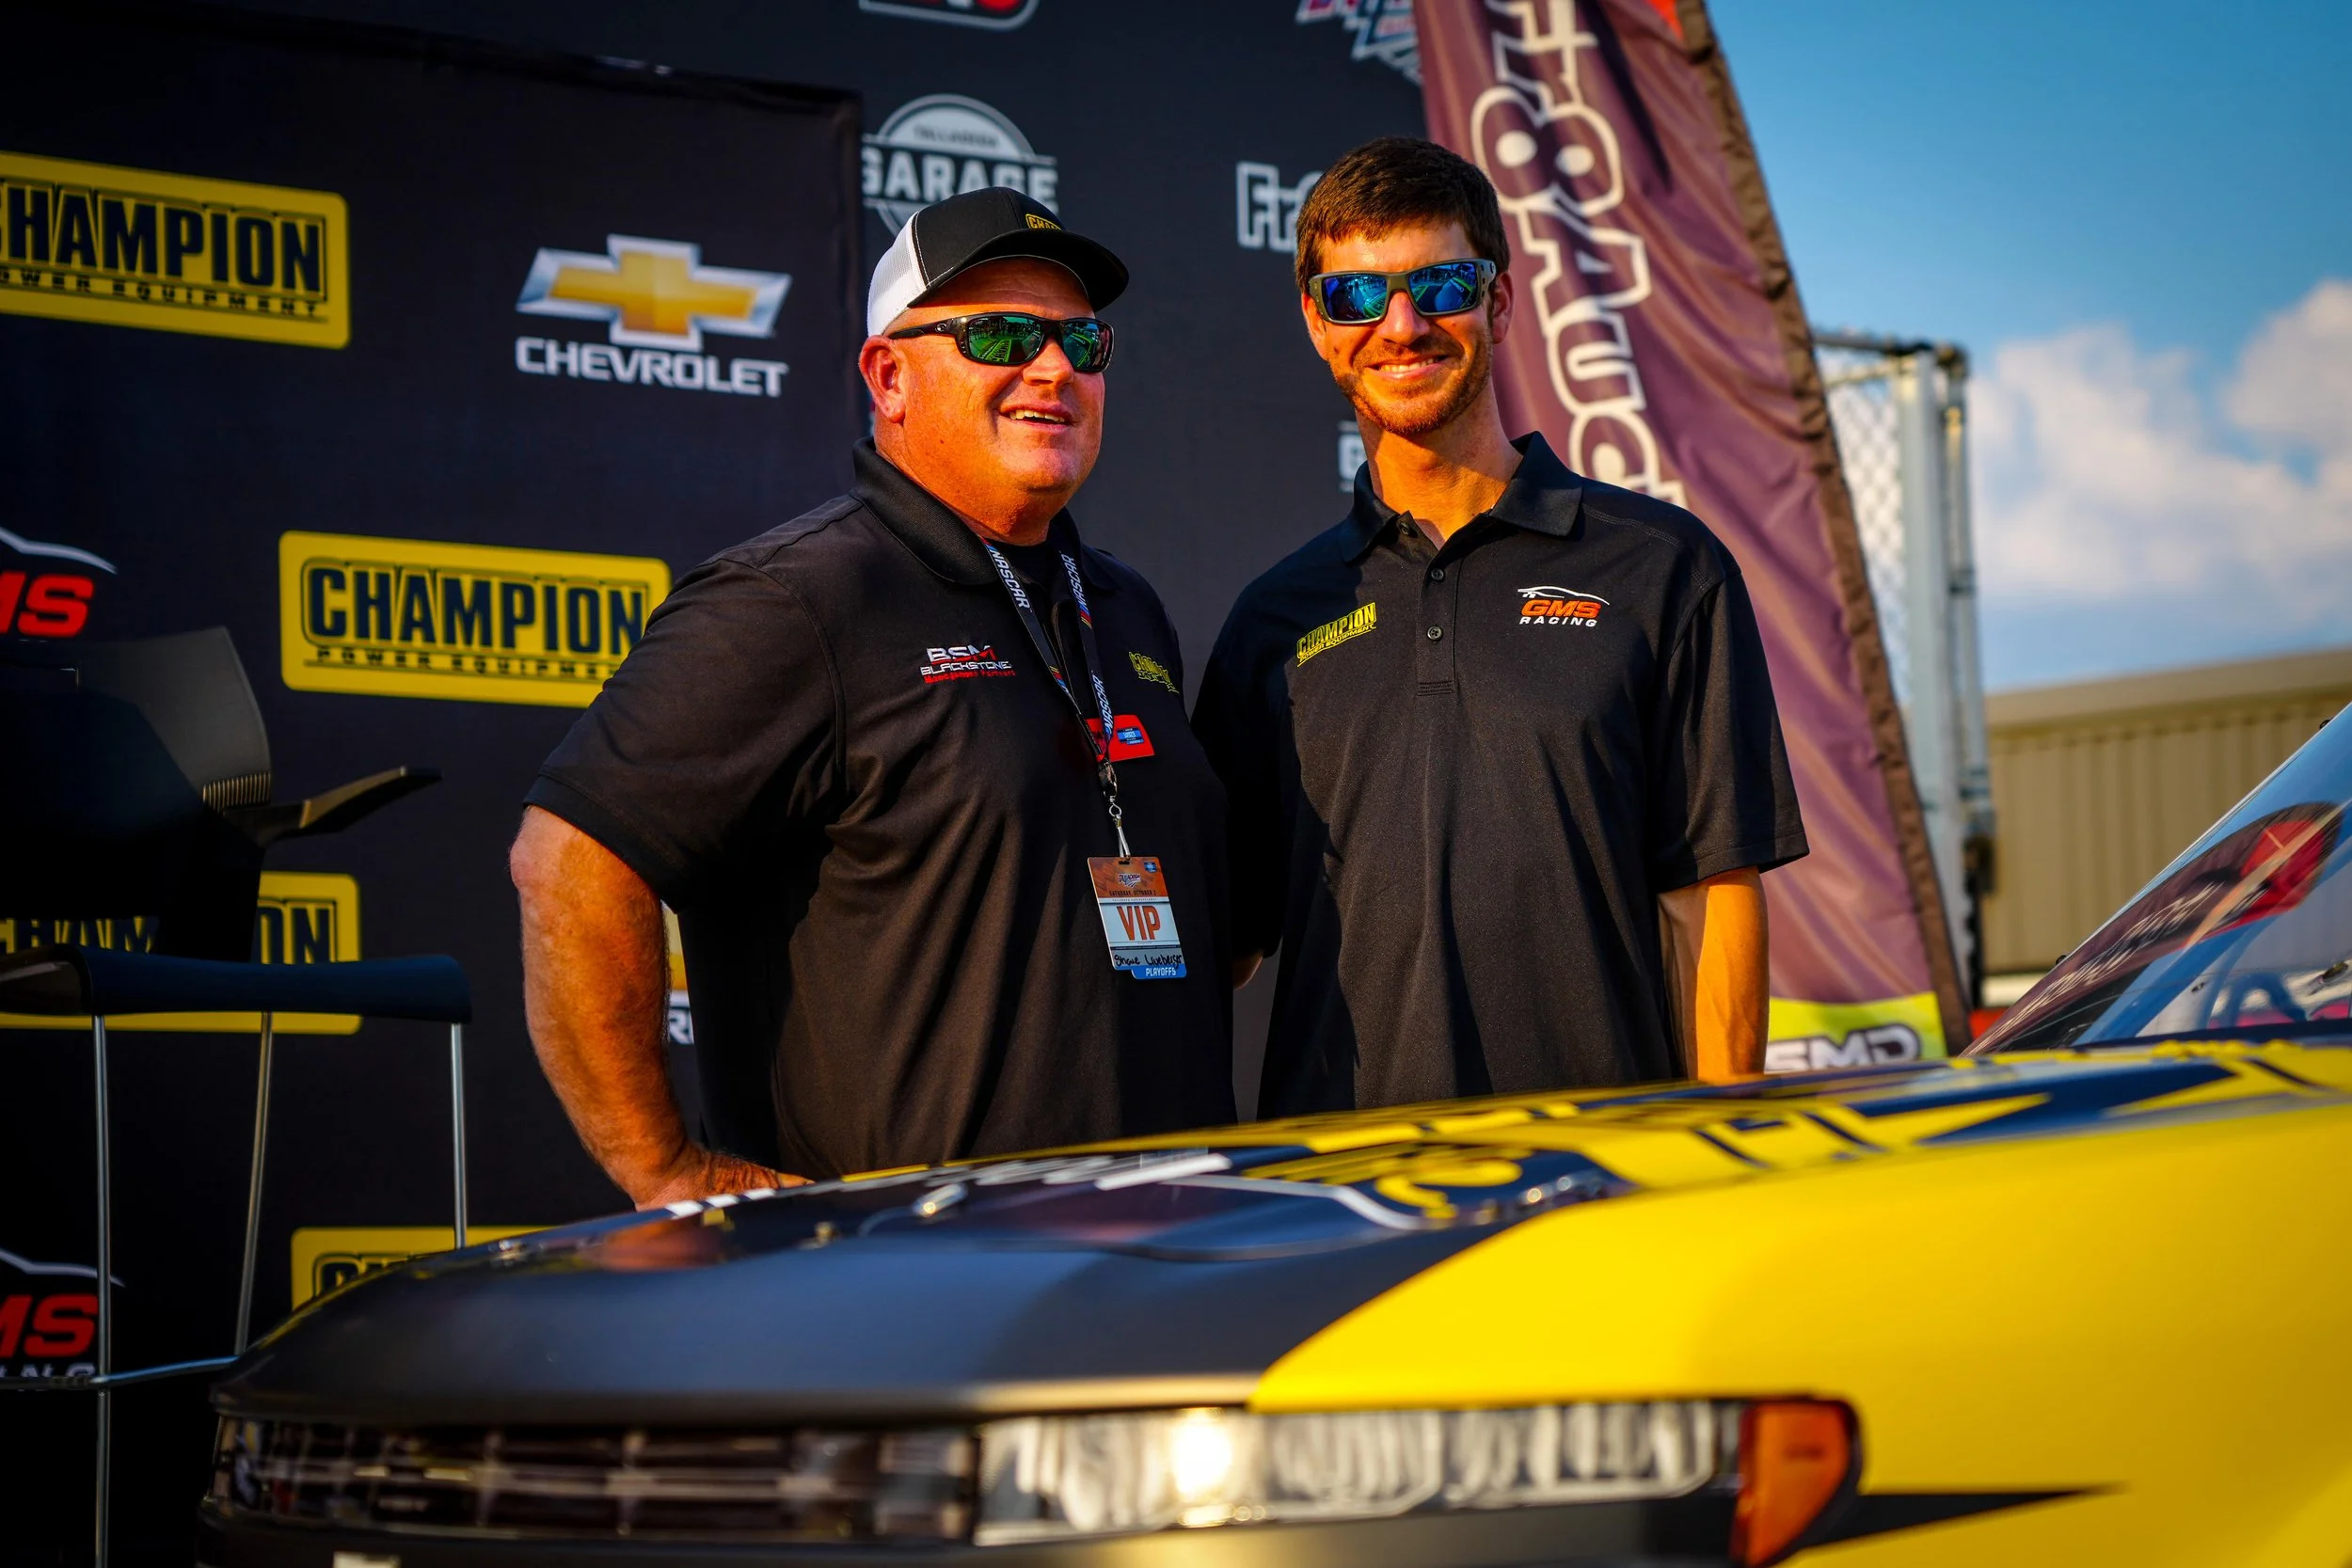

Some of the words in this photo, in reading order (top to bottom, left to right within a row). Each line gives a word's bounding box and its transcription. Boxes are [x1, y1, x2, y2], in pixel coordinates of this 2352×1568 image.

[0, 186, 321, 293] HAMPION
[515, 335, 789, 399] CHEVROLET
[989, 548, 1031, 610] NASCAR
[1060, 553, 1089, 611] NASCAR
[309, 566, 644, 657] CHAMPION
[1297, 604, 1375, 657] CHAMPION
[1518, 615, 1597, 627] RACING
[1521, 599, 1601, 618] GMS
[919, 660, 1012, 675] BLACKSTONE
[926, 644, 997, 663] BSM
[1116, 905, 1161, 942] VIP
[1145, 966, 1177, 977] PLAYOFFS
